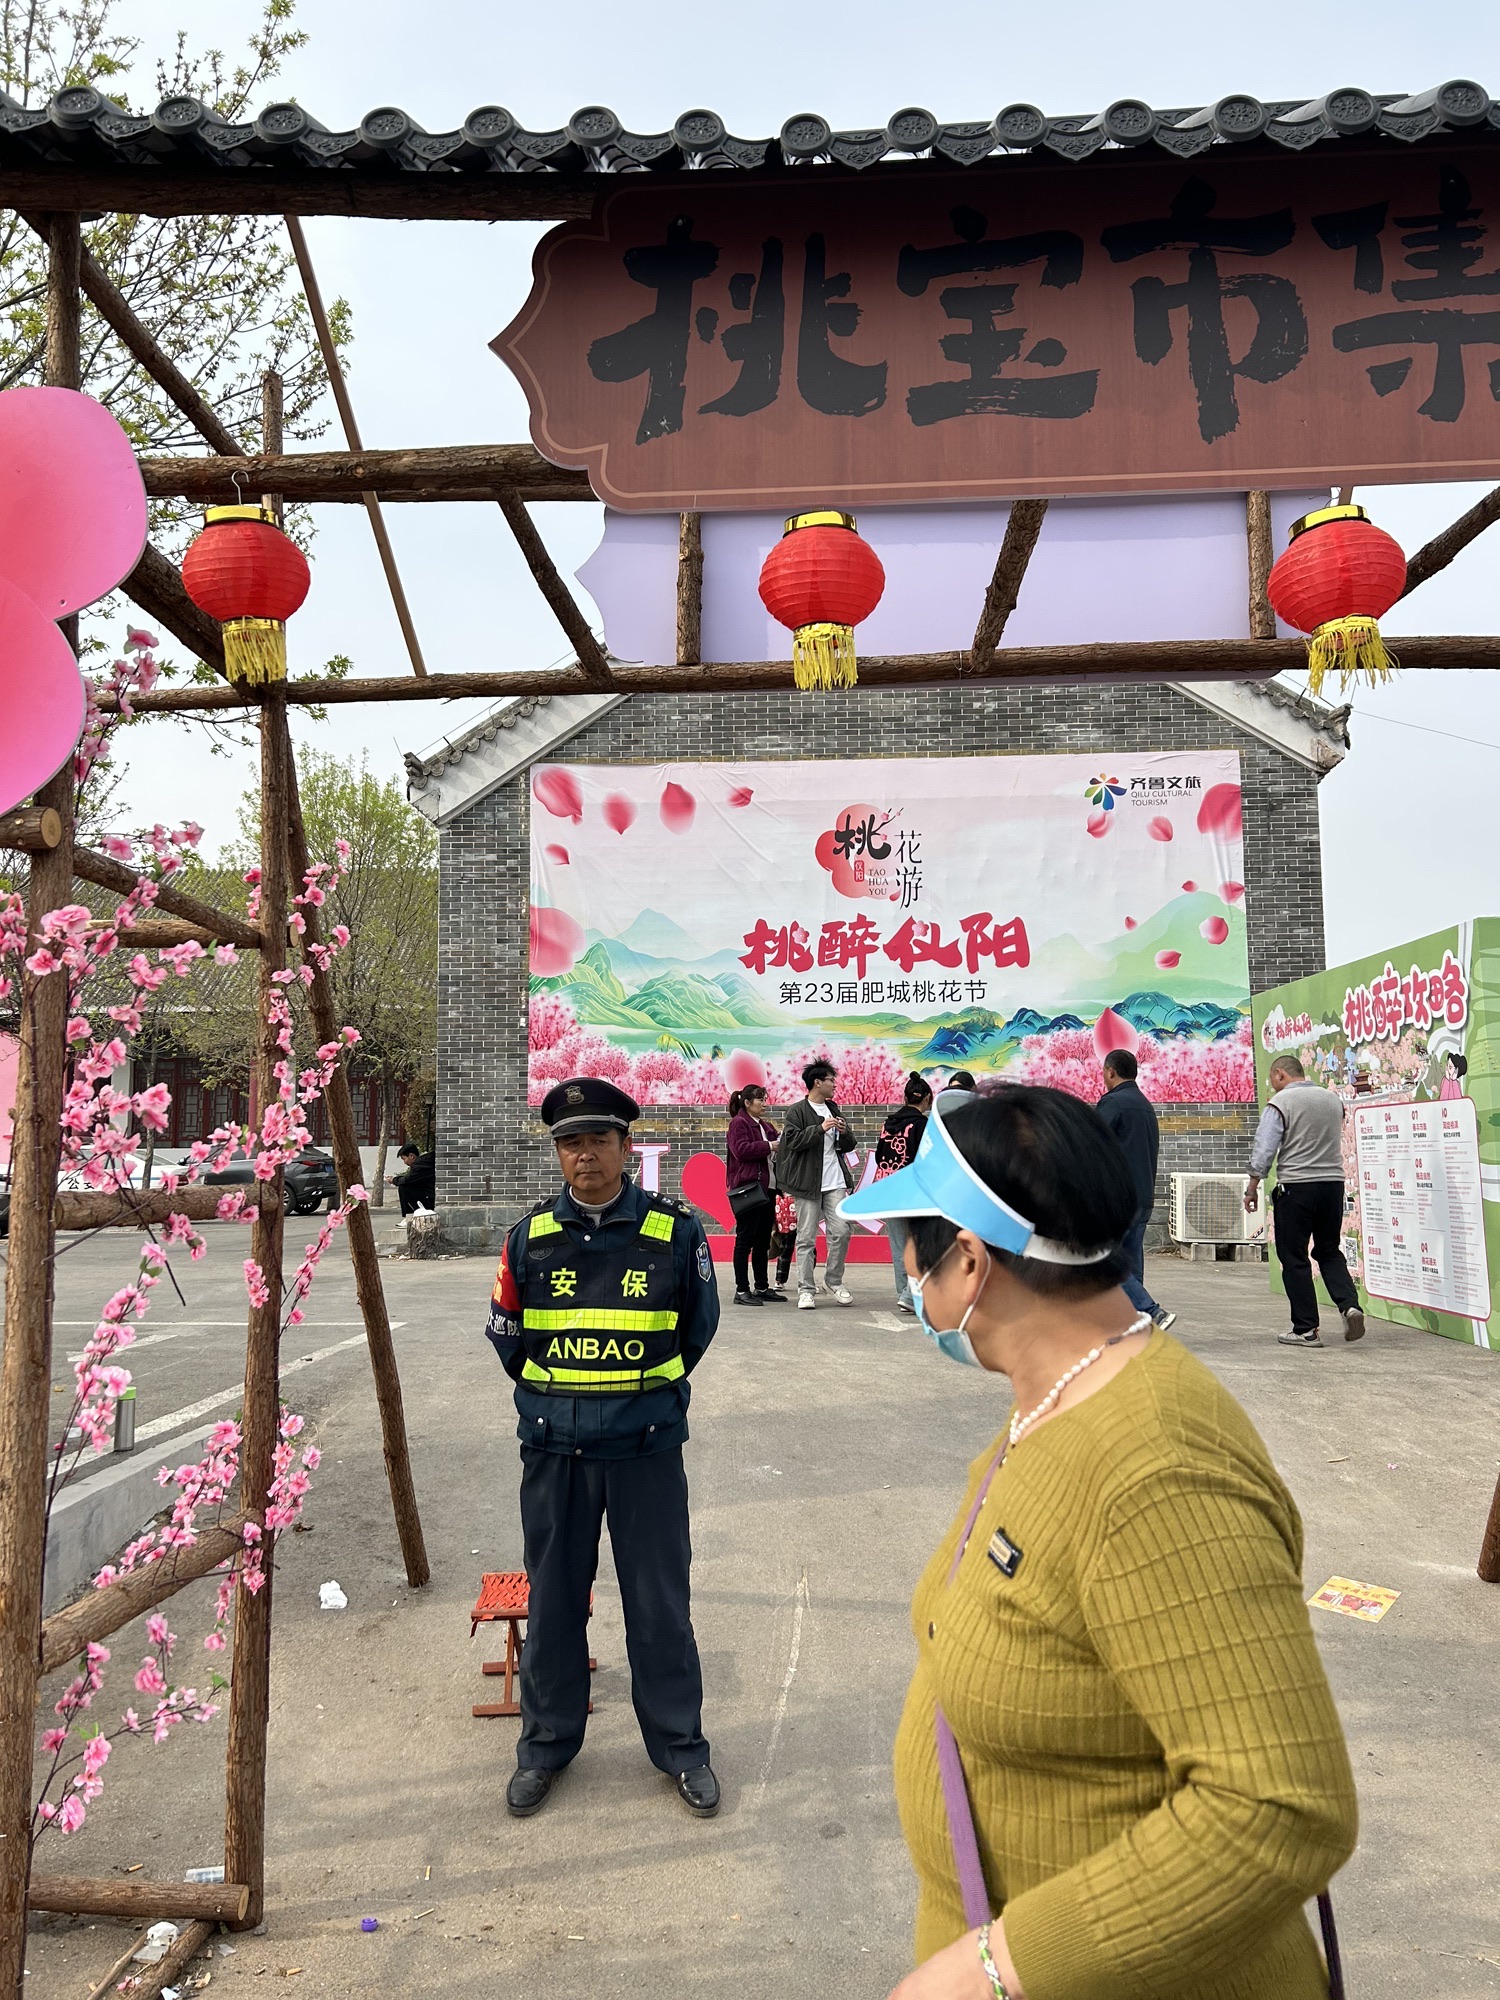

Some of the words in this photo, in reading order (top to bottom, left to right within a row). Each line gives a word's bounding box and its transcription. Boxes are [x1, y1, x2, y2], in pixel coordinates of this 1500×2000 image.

[1130, 776, 1202, 790] 齐鲁文旅
[1130, 790, 1150, 798] QILU
[1152, 789, 1193, 798] CULTURAL
[1131, 798, 1168, 807] TOURISM
[832, 813, 893, 861] 桃
[867, 868, 887, 877] TAO
[894, 829, 924, 910] 花游
[868, 878, 890, 887] HUA
[868, 888, 889, 896] YOU
[737, 911, 1031, 981] 桃醉仪阳
[778, 980, 989, 1006] 第23届肥城桃花节
[1344, 955, 1467, 1042] 桃醉攻略
[550, 1266, 578, 1298] 安
[620, 1267, 649, 1299] 保
[546, 1337, 646, 1361] ANBAO
